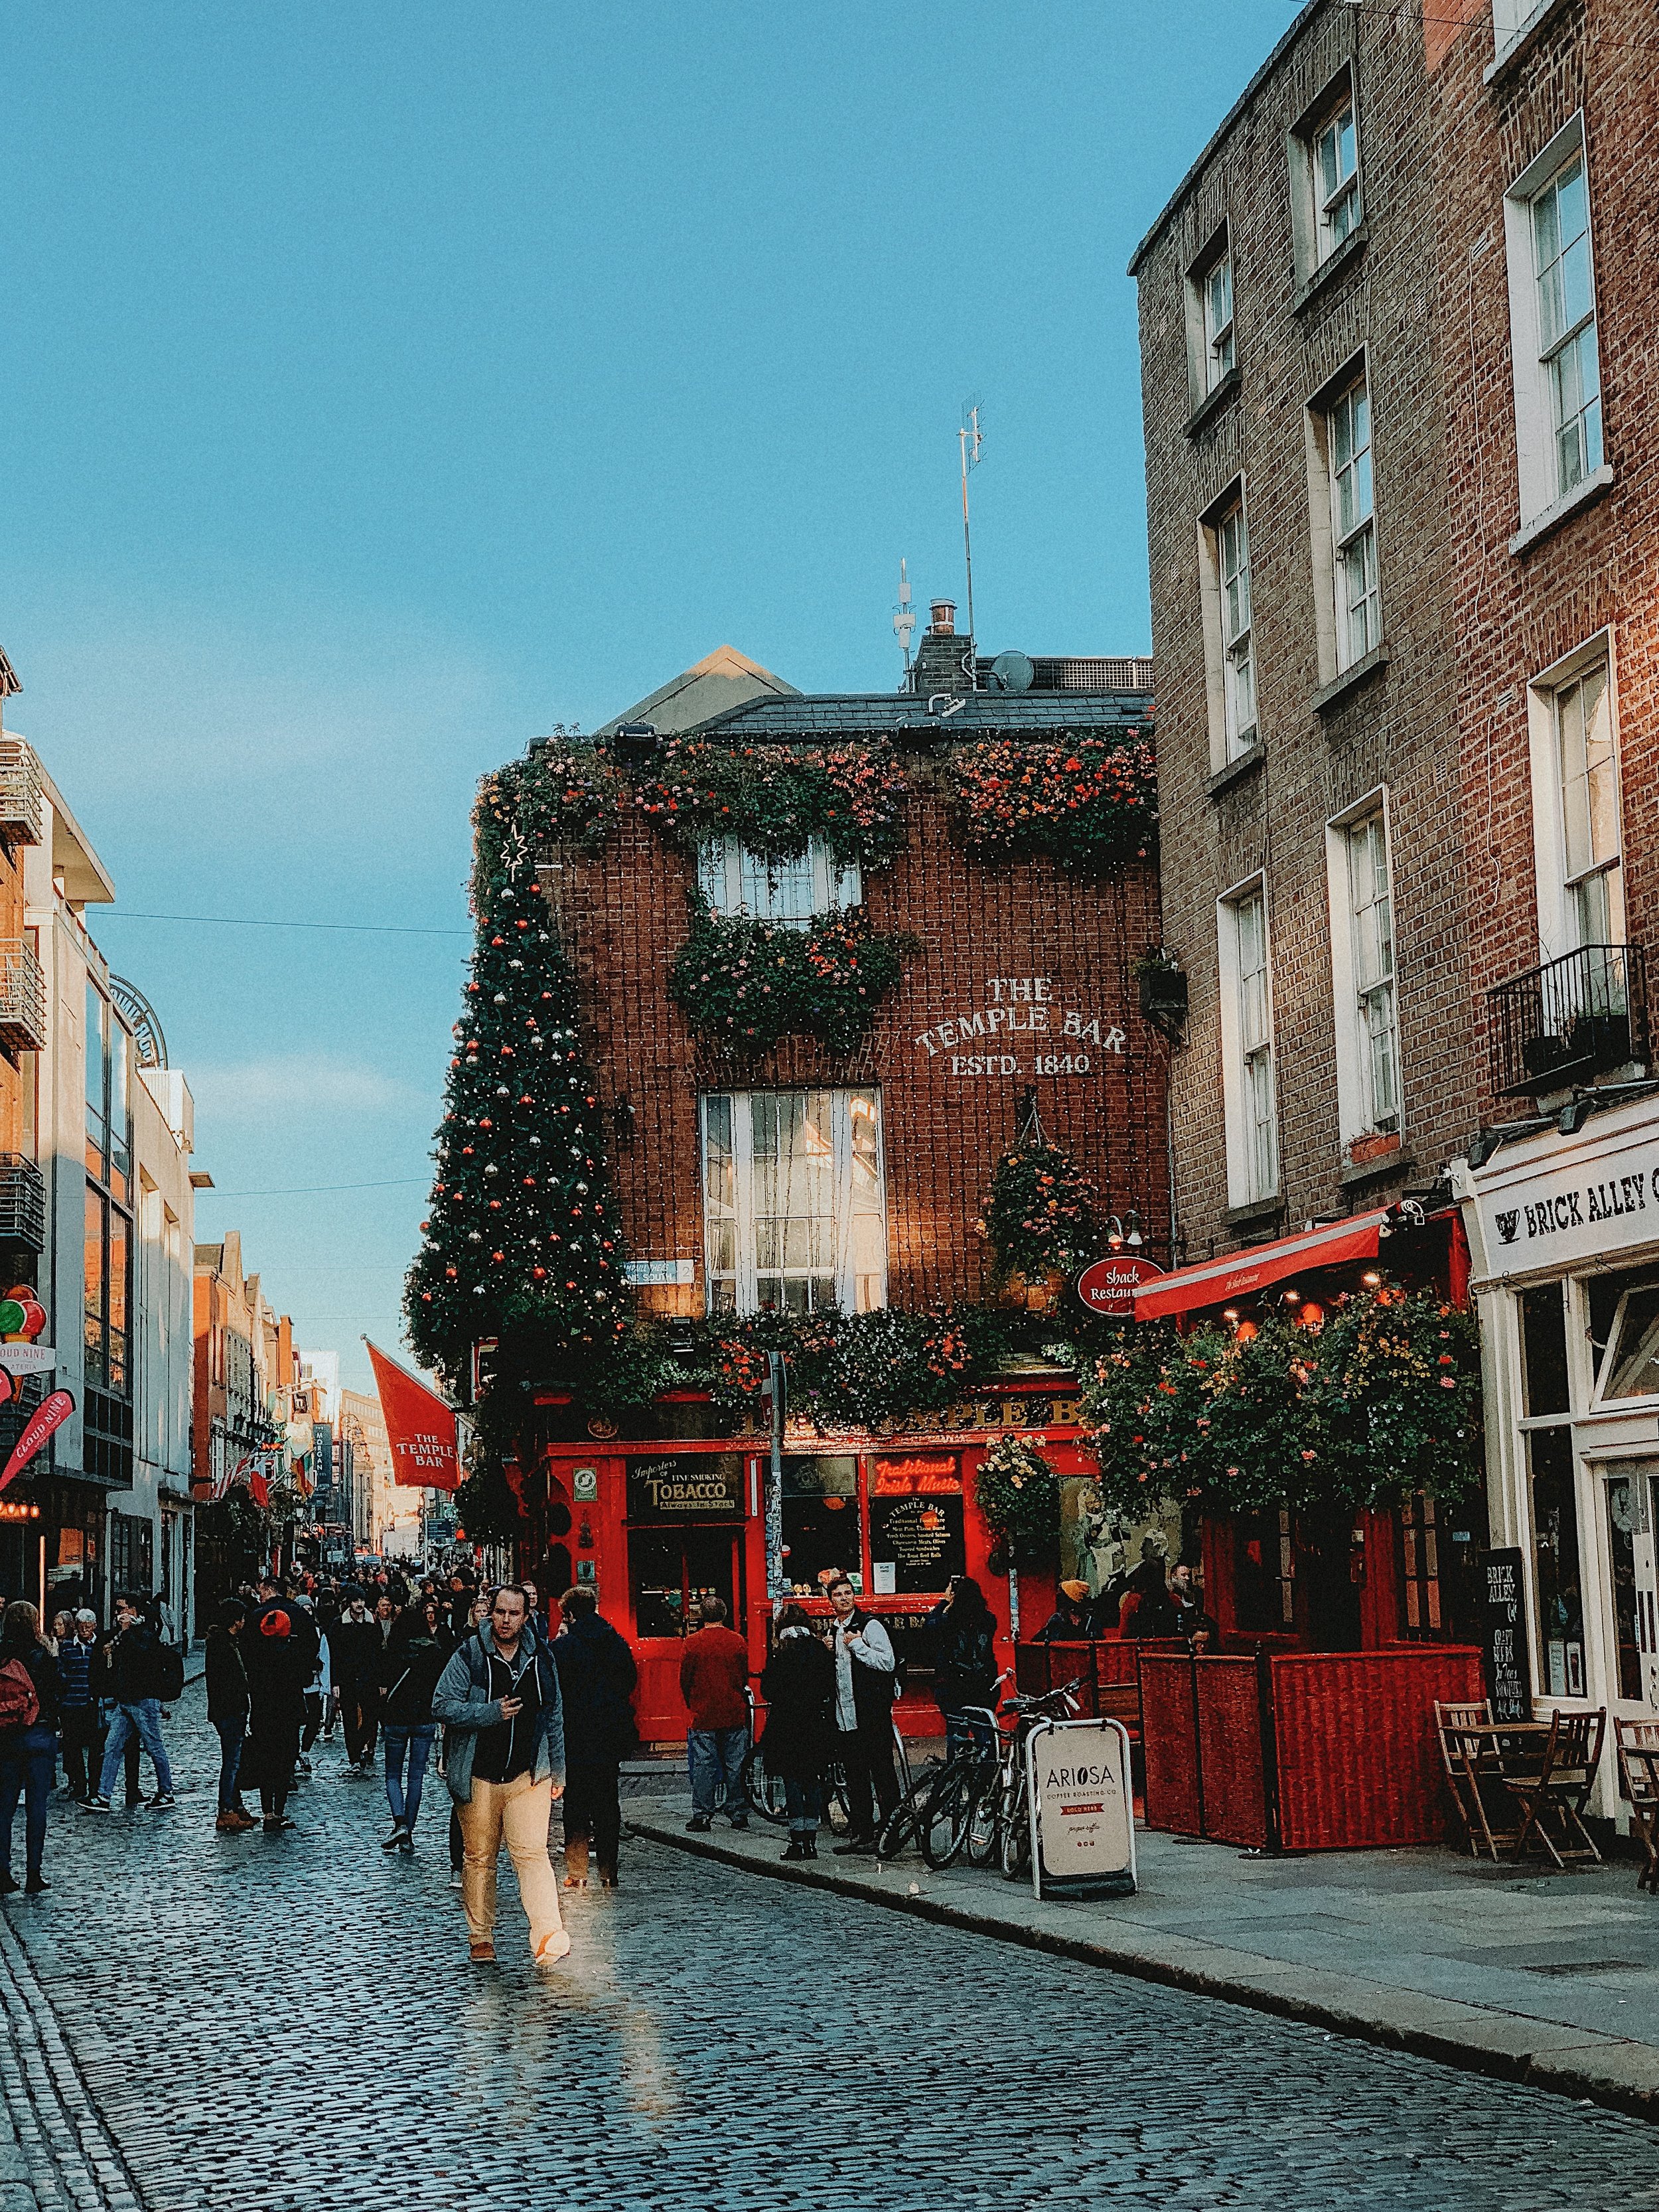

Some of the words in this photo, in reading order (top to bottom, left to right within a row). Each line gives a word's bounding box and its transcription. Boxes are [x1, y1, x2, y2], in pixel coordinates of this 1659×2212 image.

[987, 978, 1052, 1002] THE
[914, 1006, 1050, 1057] TEMPLE
[1062, 1011, 1127, 1054] BAR
[951, 1055, 1023, 1076] ESTD.
[1035, 1054, 1090, 1074] 1840
[1524, 1191, 1585, 1238] BRICK
[1587, 1173, 1646, 1223] ALLEY
[642, 1273, 672, 1282] SOUTH
[682, 1266, 690, 1277] 2
[1106, 1265, 1140, 1286] Shack
[23, 1349, 45, 1360] NINE
[16, 1424, 46, 1458] CLOUD
[44, 1396, 66, 1424] NINE
[414, 1434, 439, 1443] THE
[396, 1443, 454, 1459] TEMPLE
[415, 1455, 444, 1468] BAR
[631, 1460, 676, 1479] Importers
[875, 1456, 956, 1477] Traditional
[644, 1479, 726, 1506] TOBACCO
[874, 1476, 913, 1494] Irish
[917, 1475, 960, 1492] Music
[889, 1501, 925, 1518] TEMPLE
[928, 1503, 945, 1517] BAR
[1487, 1566, 1513, 1584] BRICK
[1488, 1584, 1515, 1603] ALLEY
[1046, 1765, 1115, 1788] ARIOSA
